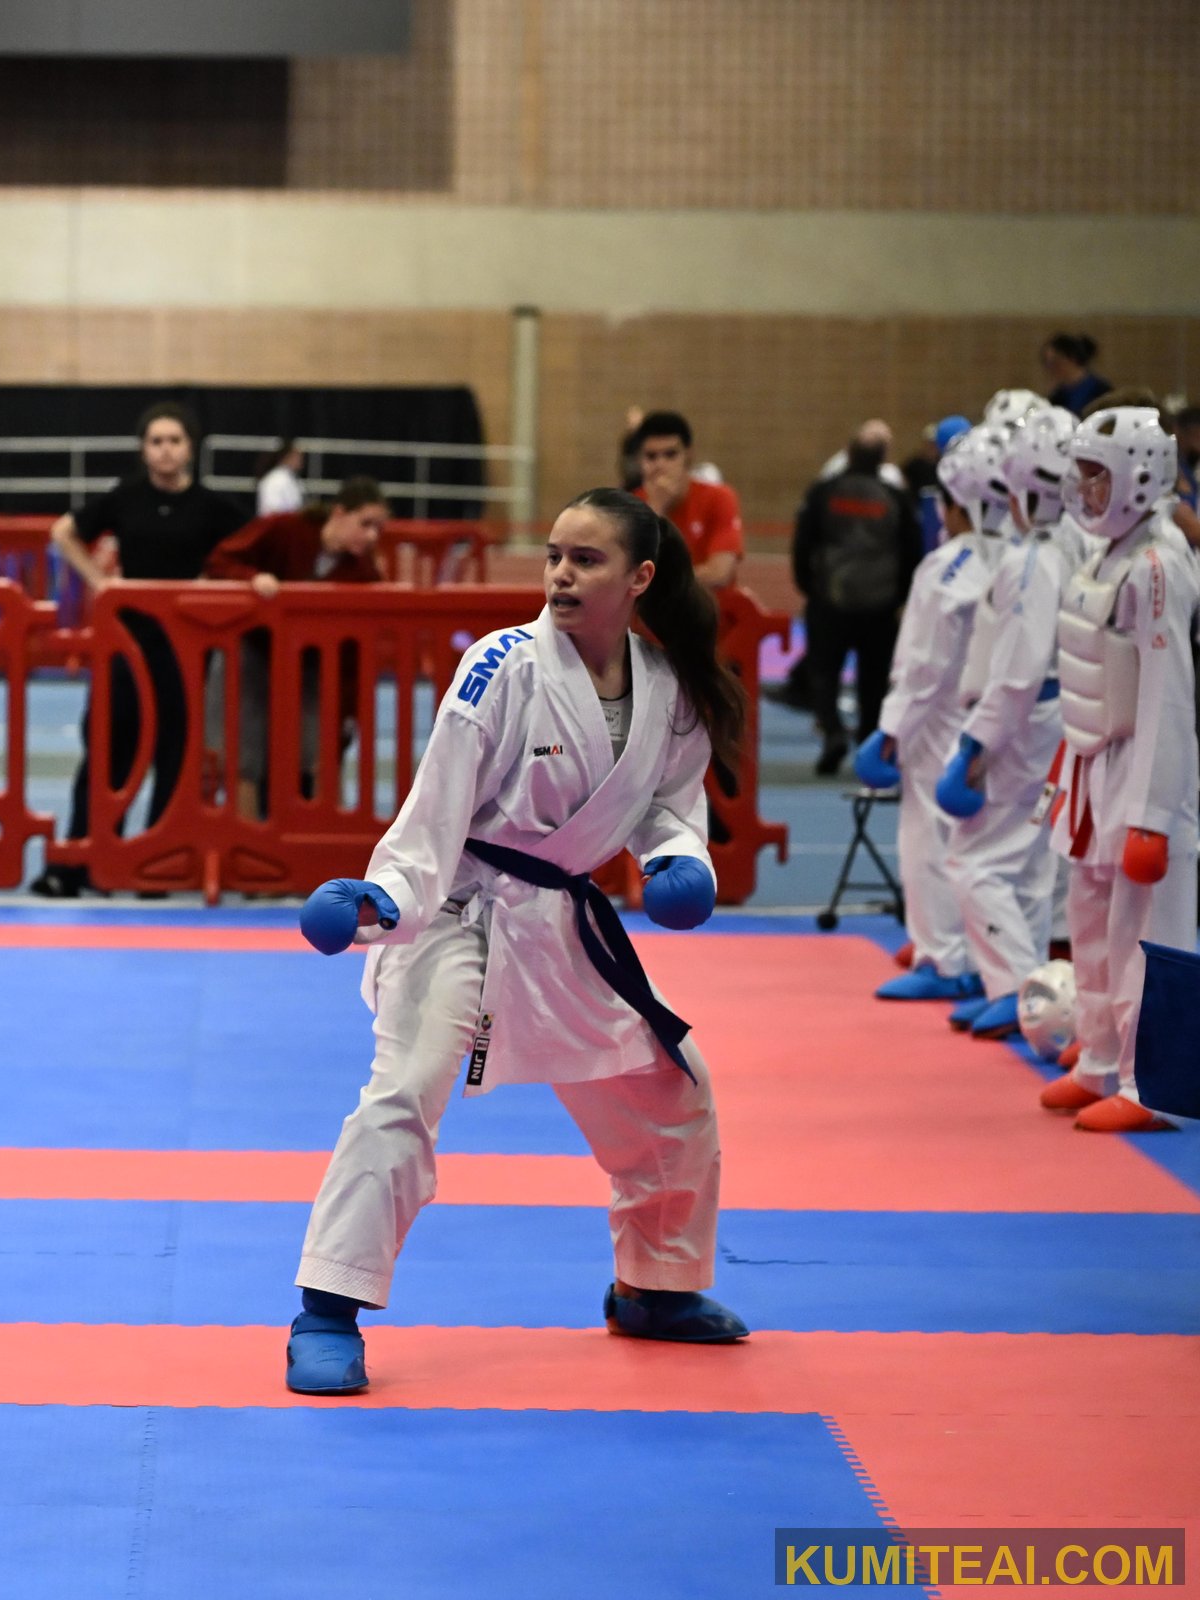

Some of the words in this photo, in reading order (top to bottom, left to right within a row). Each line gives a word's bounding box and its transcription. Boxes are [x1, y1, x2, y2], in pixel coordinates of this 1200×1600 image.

[457, 628, 534, 708] SMAI
[533, 744, 564, 757] SMAI
[471, 1053, 484, 1080] JIN
